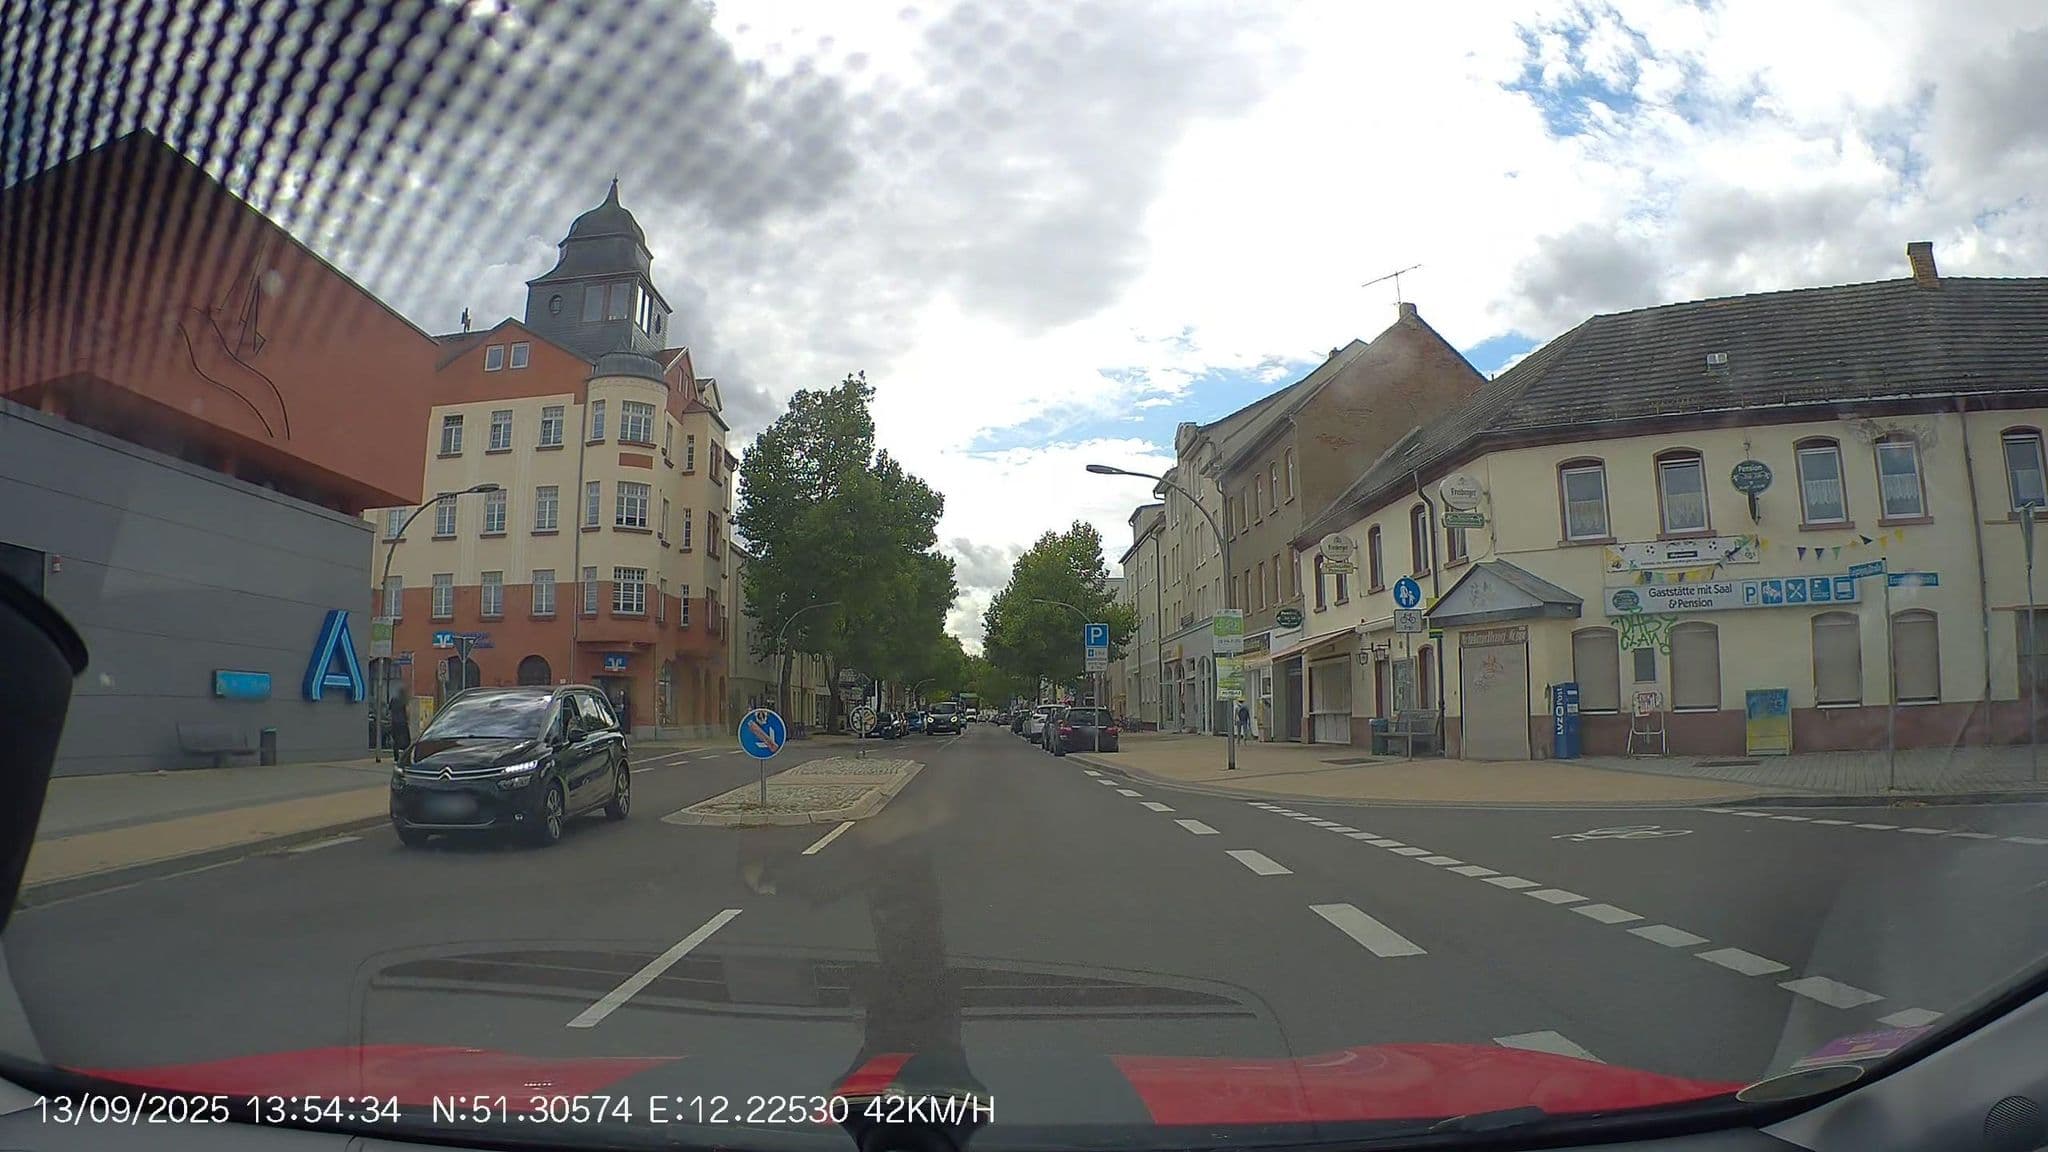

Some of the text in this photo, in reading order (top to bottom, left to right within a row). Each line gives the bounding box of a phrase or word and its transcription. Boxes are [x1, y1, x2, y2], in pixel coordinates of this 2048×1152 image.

[1648, 583, 1733, 598] Gaststätte mit Saal
[1668, 598, 1713, 609] & Pension
[1090, 626, 1103, 645] P
